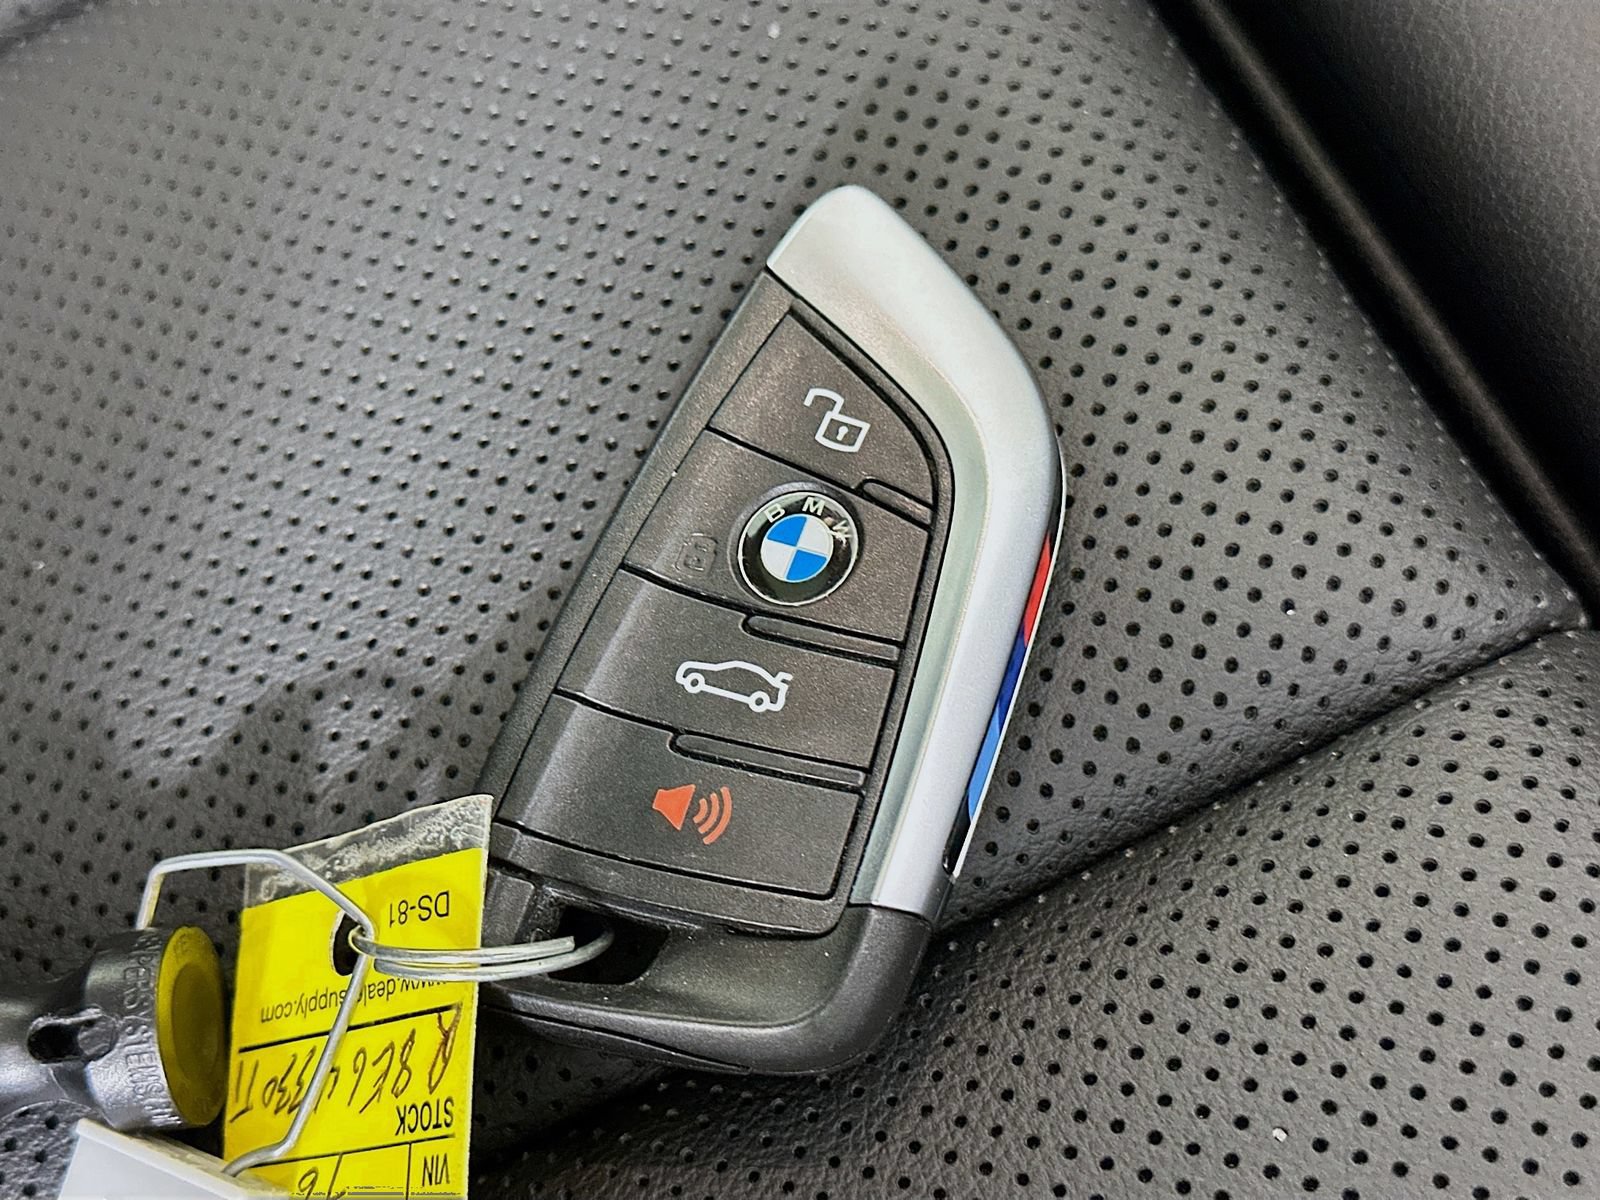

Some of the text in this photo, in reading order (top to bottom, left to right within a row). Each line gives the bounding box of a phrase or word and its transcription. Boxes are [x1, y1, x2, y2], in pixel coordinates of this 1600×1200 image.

[764, 496, 852, 548] BMW
[389, 890, 450, 928] DS-81
[395, 1096, 455, 1136] STOCK
[422, 1152, 451, 1188] VIN
